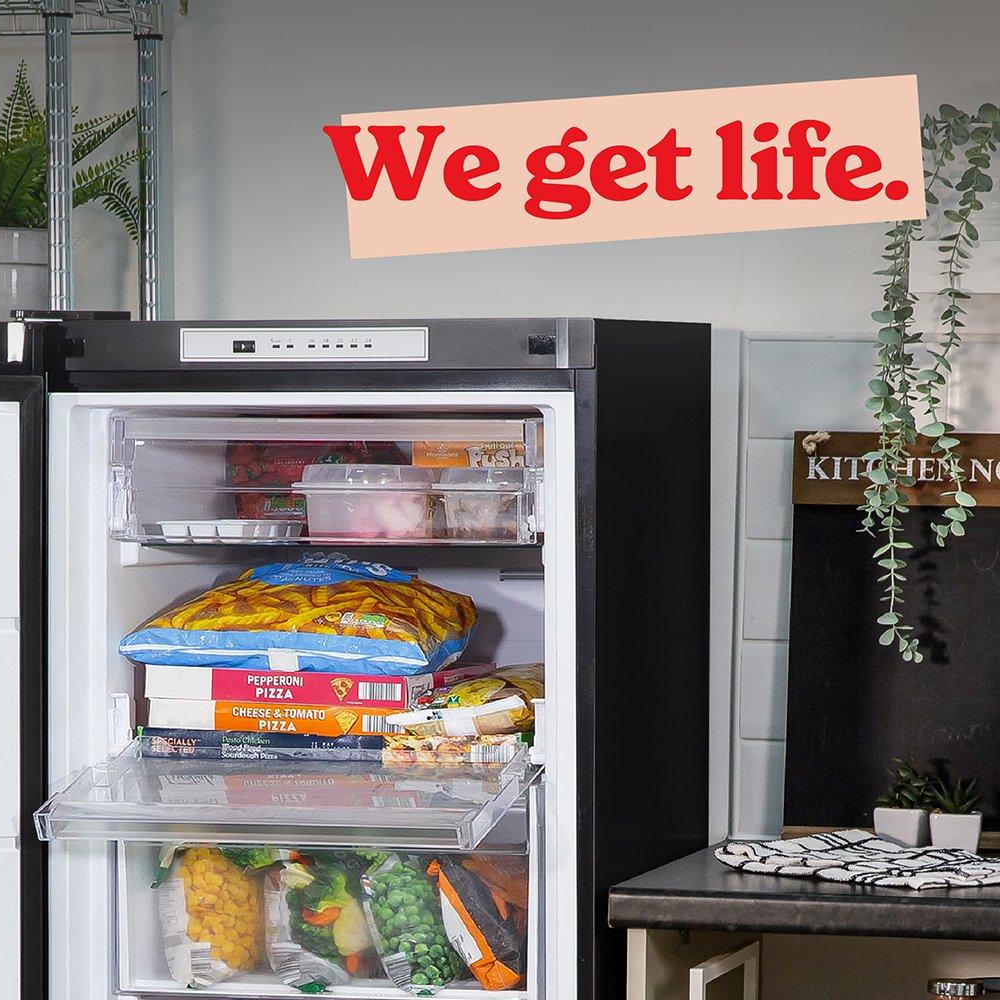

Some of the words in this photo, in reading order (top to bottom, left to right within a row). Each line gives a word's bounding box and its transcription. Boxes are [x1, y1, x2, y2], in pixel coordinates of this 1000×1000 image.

[969, 458, 1000, 482] N
[247, 675, 303, 687] PEPPERONI
[255, 688, 293, 700] PIZZA
[232, 707, 271, 719] CHEESE
[273, 708, 282, 718] &
[283, 708, 326, 720] TOMATO
[258, 720, 297, 732] PIZZA
[242, 735, 271, 744] Chicken
[151, 745, 196, 754] SELECTED
[221, 751, 259, 760] Sourdough
[260, 752, 278, 760] Pizza
